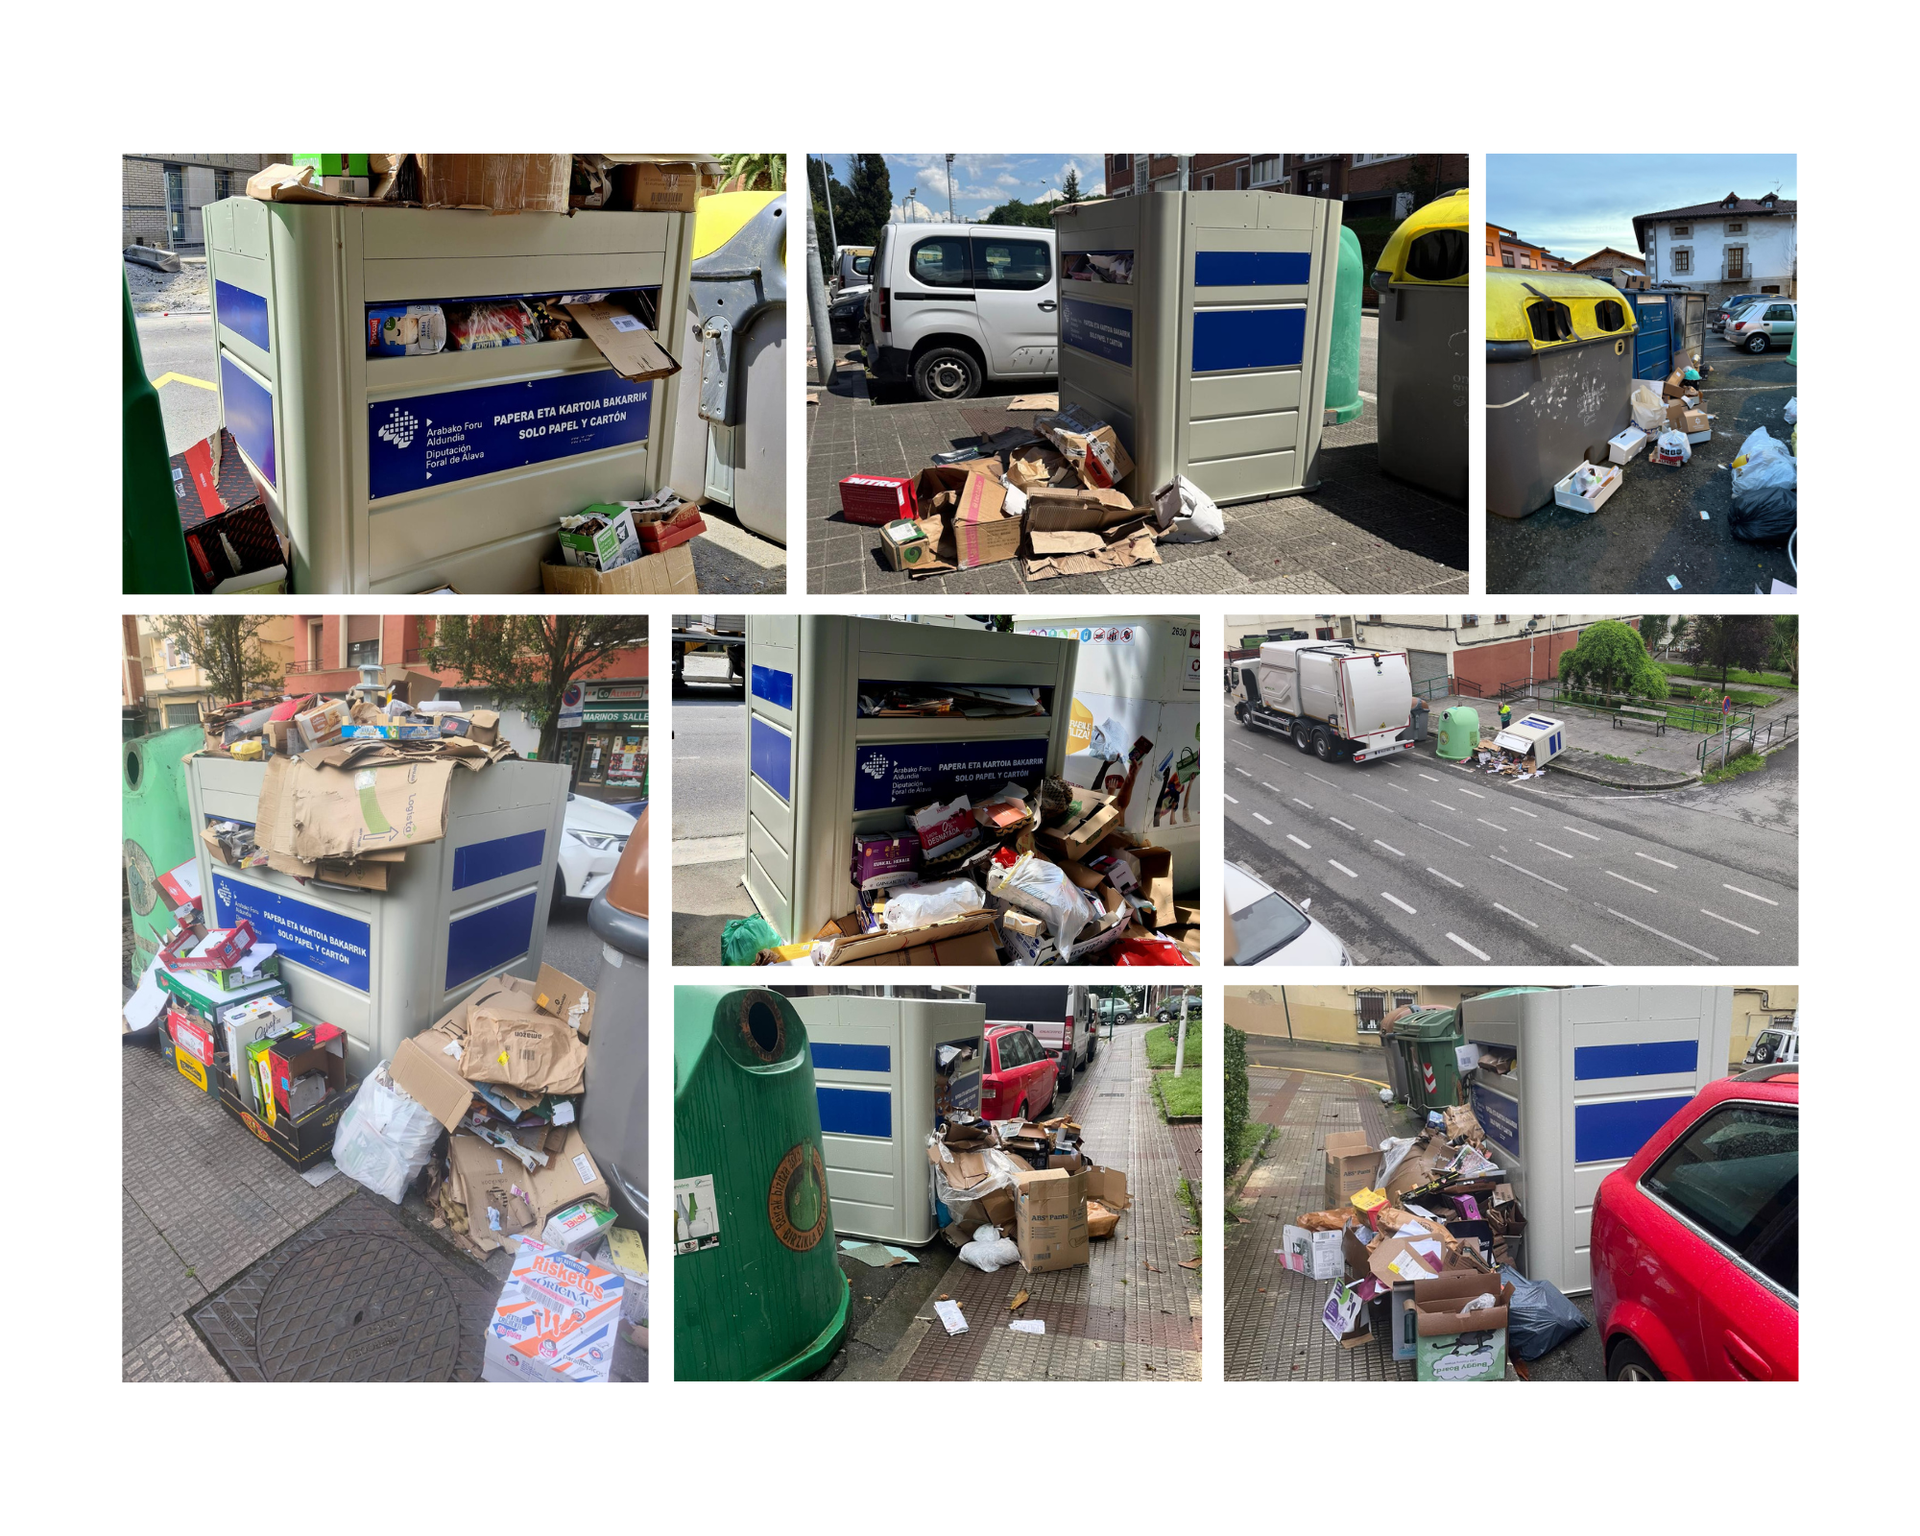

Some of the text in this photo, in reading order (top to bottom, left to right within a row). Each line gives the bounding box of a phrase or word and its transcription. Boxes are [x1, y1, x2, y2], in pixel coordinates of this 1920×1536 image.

[494, 392, 648, 426] PAPERA ETA KARTOIA BAKARRIK
[426, 421, 483, 437] Arabako Foru
[518, 410, 627, 440] SOLO PAPEL Y CARTÓN
[426, 433, 465, 447] Aldundia
[426, 444, 471, 459] Diputación
[426, 451, 485, 469] Foral de Álava
[848, 477, 901, 488] NITRO
[1171, 627, 1187, 637] 2630
[583, 712, 619, 721] MARINOS
[893, 765, 932, 774] Arabako Foru
[939, 757, 1044, 771] PAPERA ETA KARTOIA BAKARRIK
[955, 774, 974, 782] SOLO
[975, 772, 996, 781] PAPEL
[1003, 769, 1029, 778] CARTÓN
[892, 780, 924, 788] Diputación
[892, 787, 907, 796] Foral
[405, 793, 417, 833] Logista
[927, 827, 960, 846] DESNATADA
[263, 911, 367, 958] PAPERA ETA KARTOIA BAKARRIK
[277, 929, 350, 965] SOLO PAPEL Y CARTÓN
[514, 1031, 542, 1039] amazon
[773, 1168, 791, 1198] bizitza
[563, 1211, 588, 1229] ARIEL
[532, 1255, 605, 1301] Risketos
[536, 1277, 591, 1309] ORIGINAL
[1436, 1361, 1488, 1374] Buggy Board
